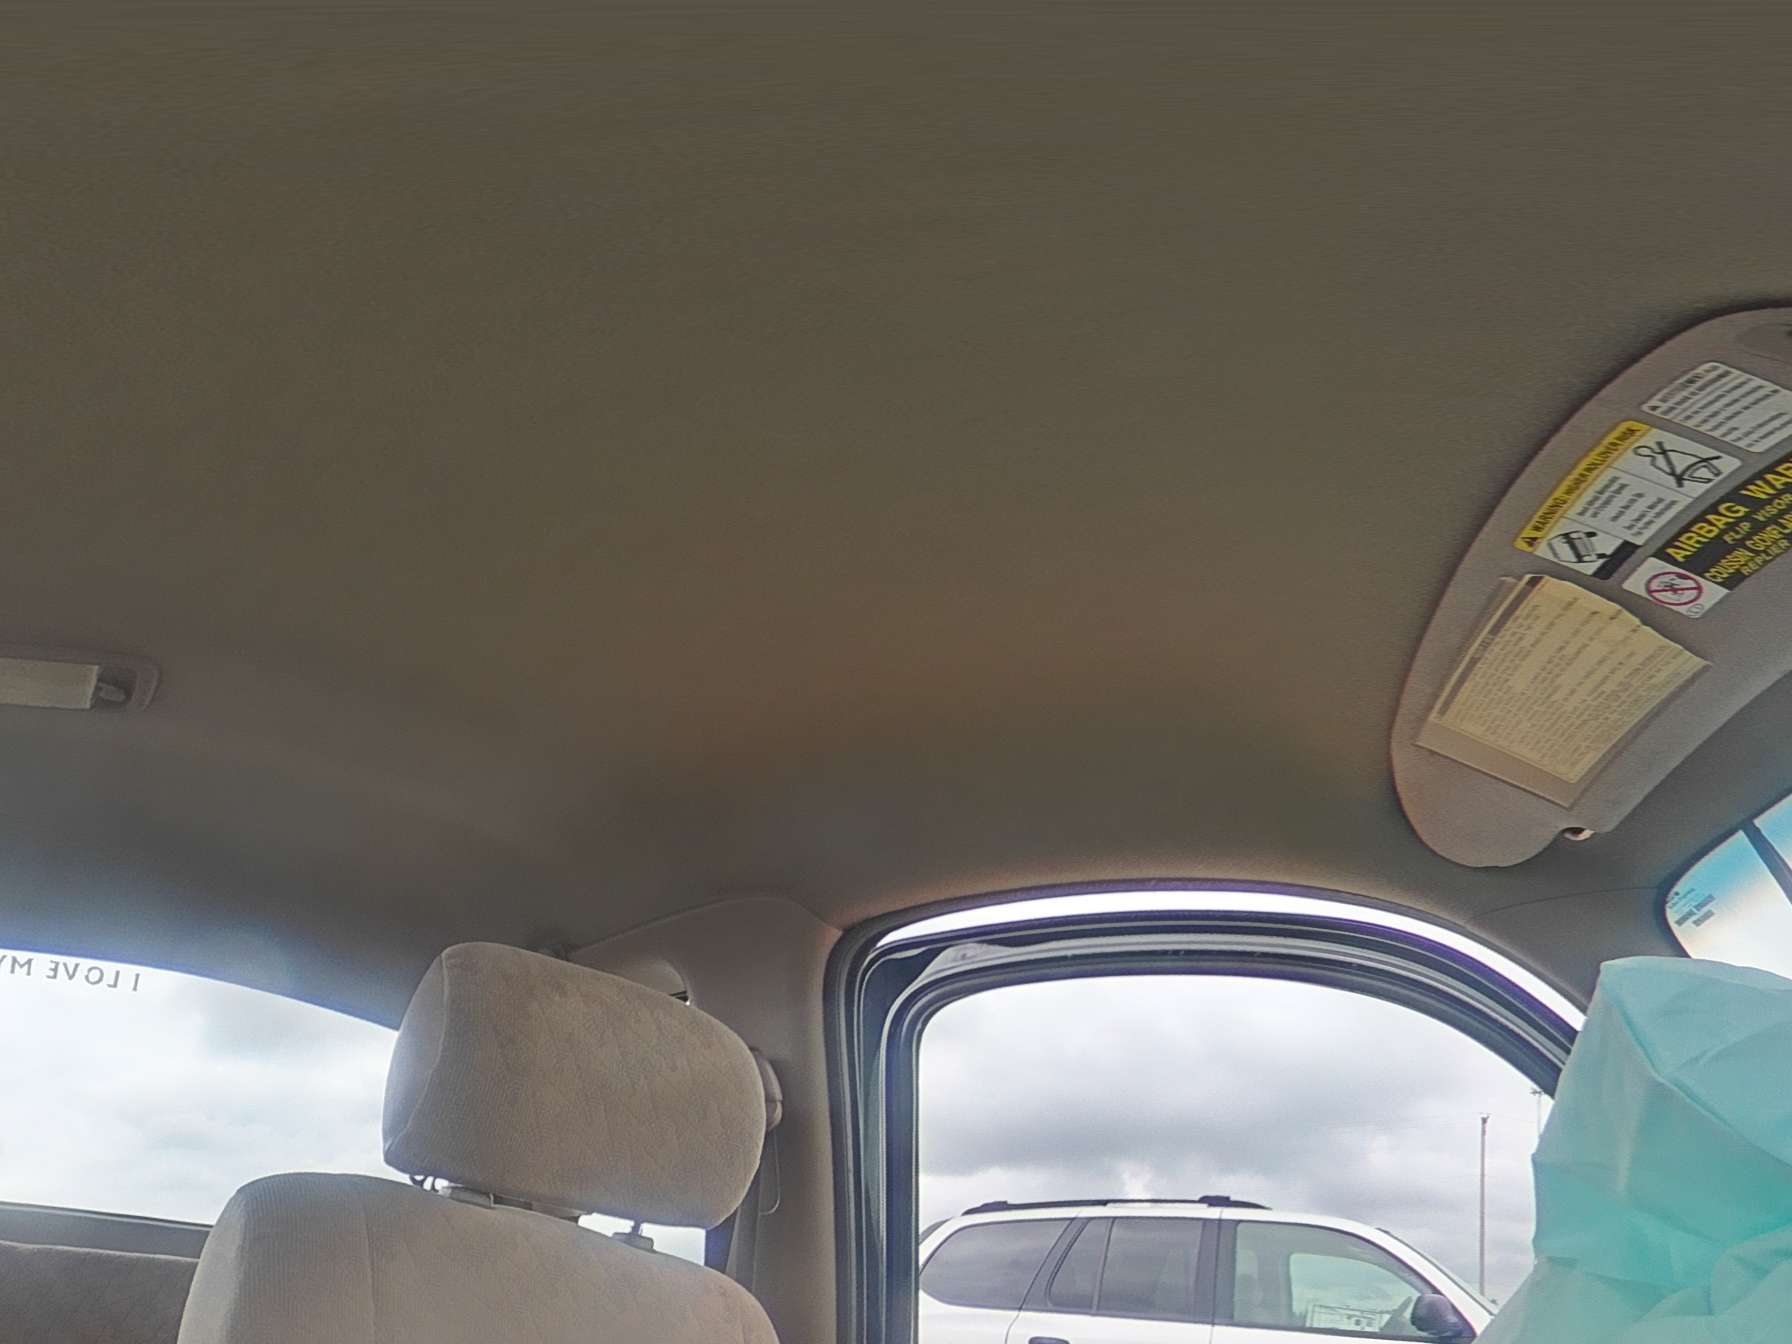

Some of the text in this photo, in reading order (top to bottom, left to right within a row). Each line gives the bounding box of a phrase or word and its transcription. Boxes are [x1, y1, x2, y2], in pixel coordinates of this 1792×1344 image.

[1665, 502, 1750, 562] AIRBAG
[1722, 522, 1752, 545] FLIP
[1703, 542, 1754, 583] COUSSIN
[1740, 538, 1791, 576] REPLIER
